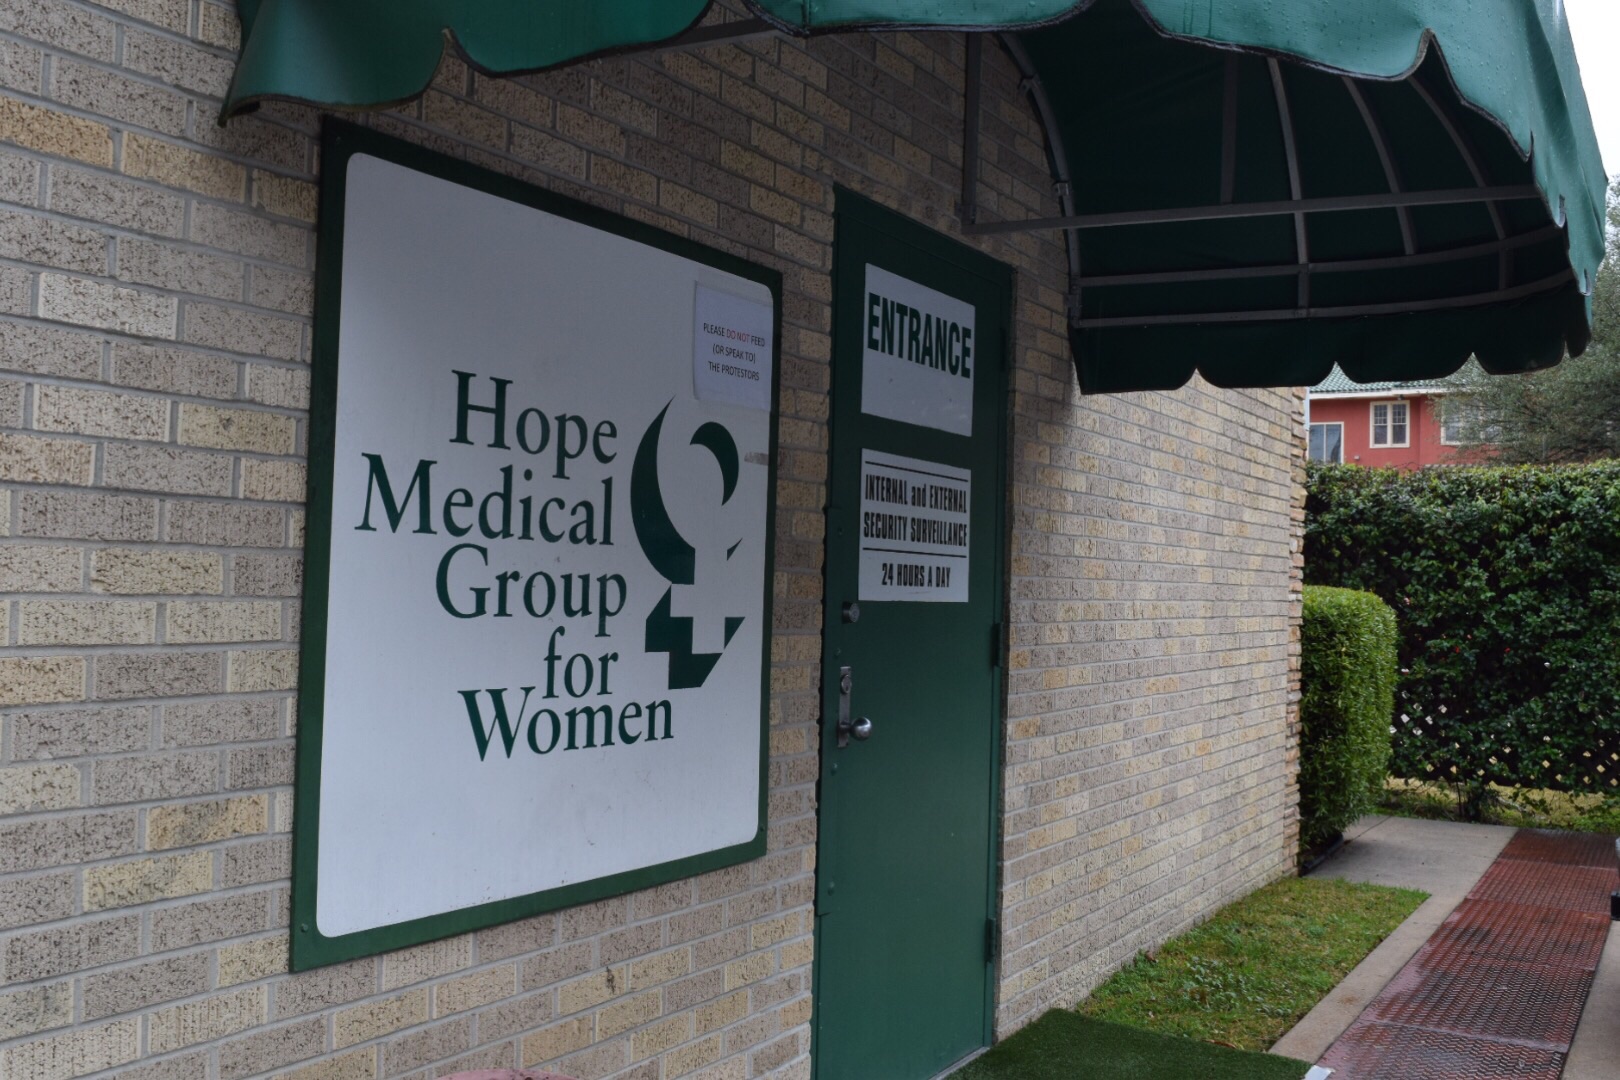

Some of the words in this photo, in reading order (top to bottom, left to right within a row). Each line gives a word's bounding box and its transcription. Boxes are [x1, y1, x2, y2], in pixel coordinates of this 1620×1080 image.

[703, 323, 725, 336] PLEASE
[726, 328, 736, 340] DO
[736, 331, 750, 343] NOT
[751, 336, 765, 347] FEED
[712, 343, 725, 356] (OR
[725, 347, 744, 360] SPEAK
[745, 351, 756, 364] TO)
[867, 292, 972, 379] ENTRANCE
[708, 361, 720, 372] THE
[721, 364, 759, 380] PROTESTORS
[449, 369, 618, 480] Hope
[354, 452, 614, 546] Medical
[865, 474, 908, 505] INTERNAL
[911, 483, 927, 508] and
[929, 485, 967, 513] EXTERNAL
[863, 511, 908, 541] SECURITY
[910, 517, 967, 547] SURVEILLANCE
[436, 543, 627, 637] Group
[881, 562, 894, 586] 24
[897, 563, 925, 587] HOURS
[927, 565, 933, 587] A
[935, 566, 951, 588] DAY
[542, 625, 619, 699] for
[457, 686, 674, 762] Women
